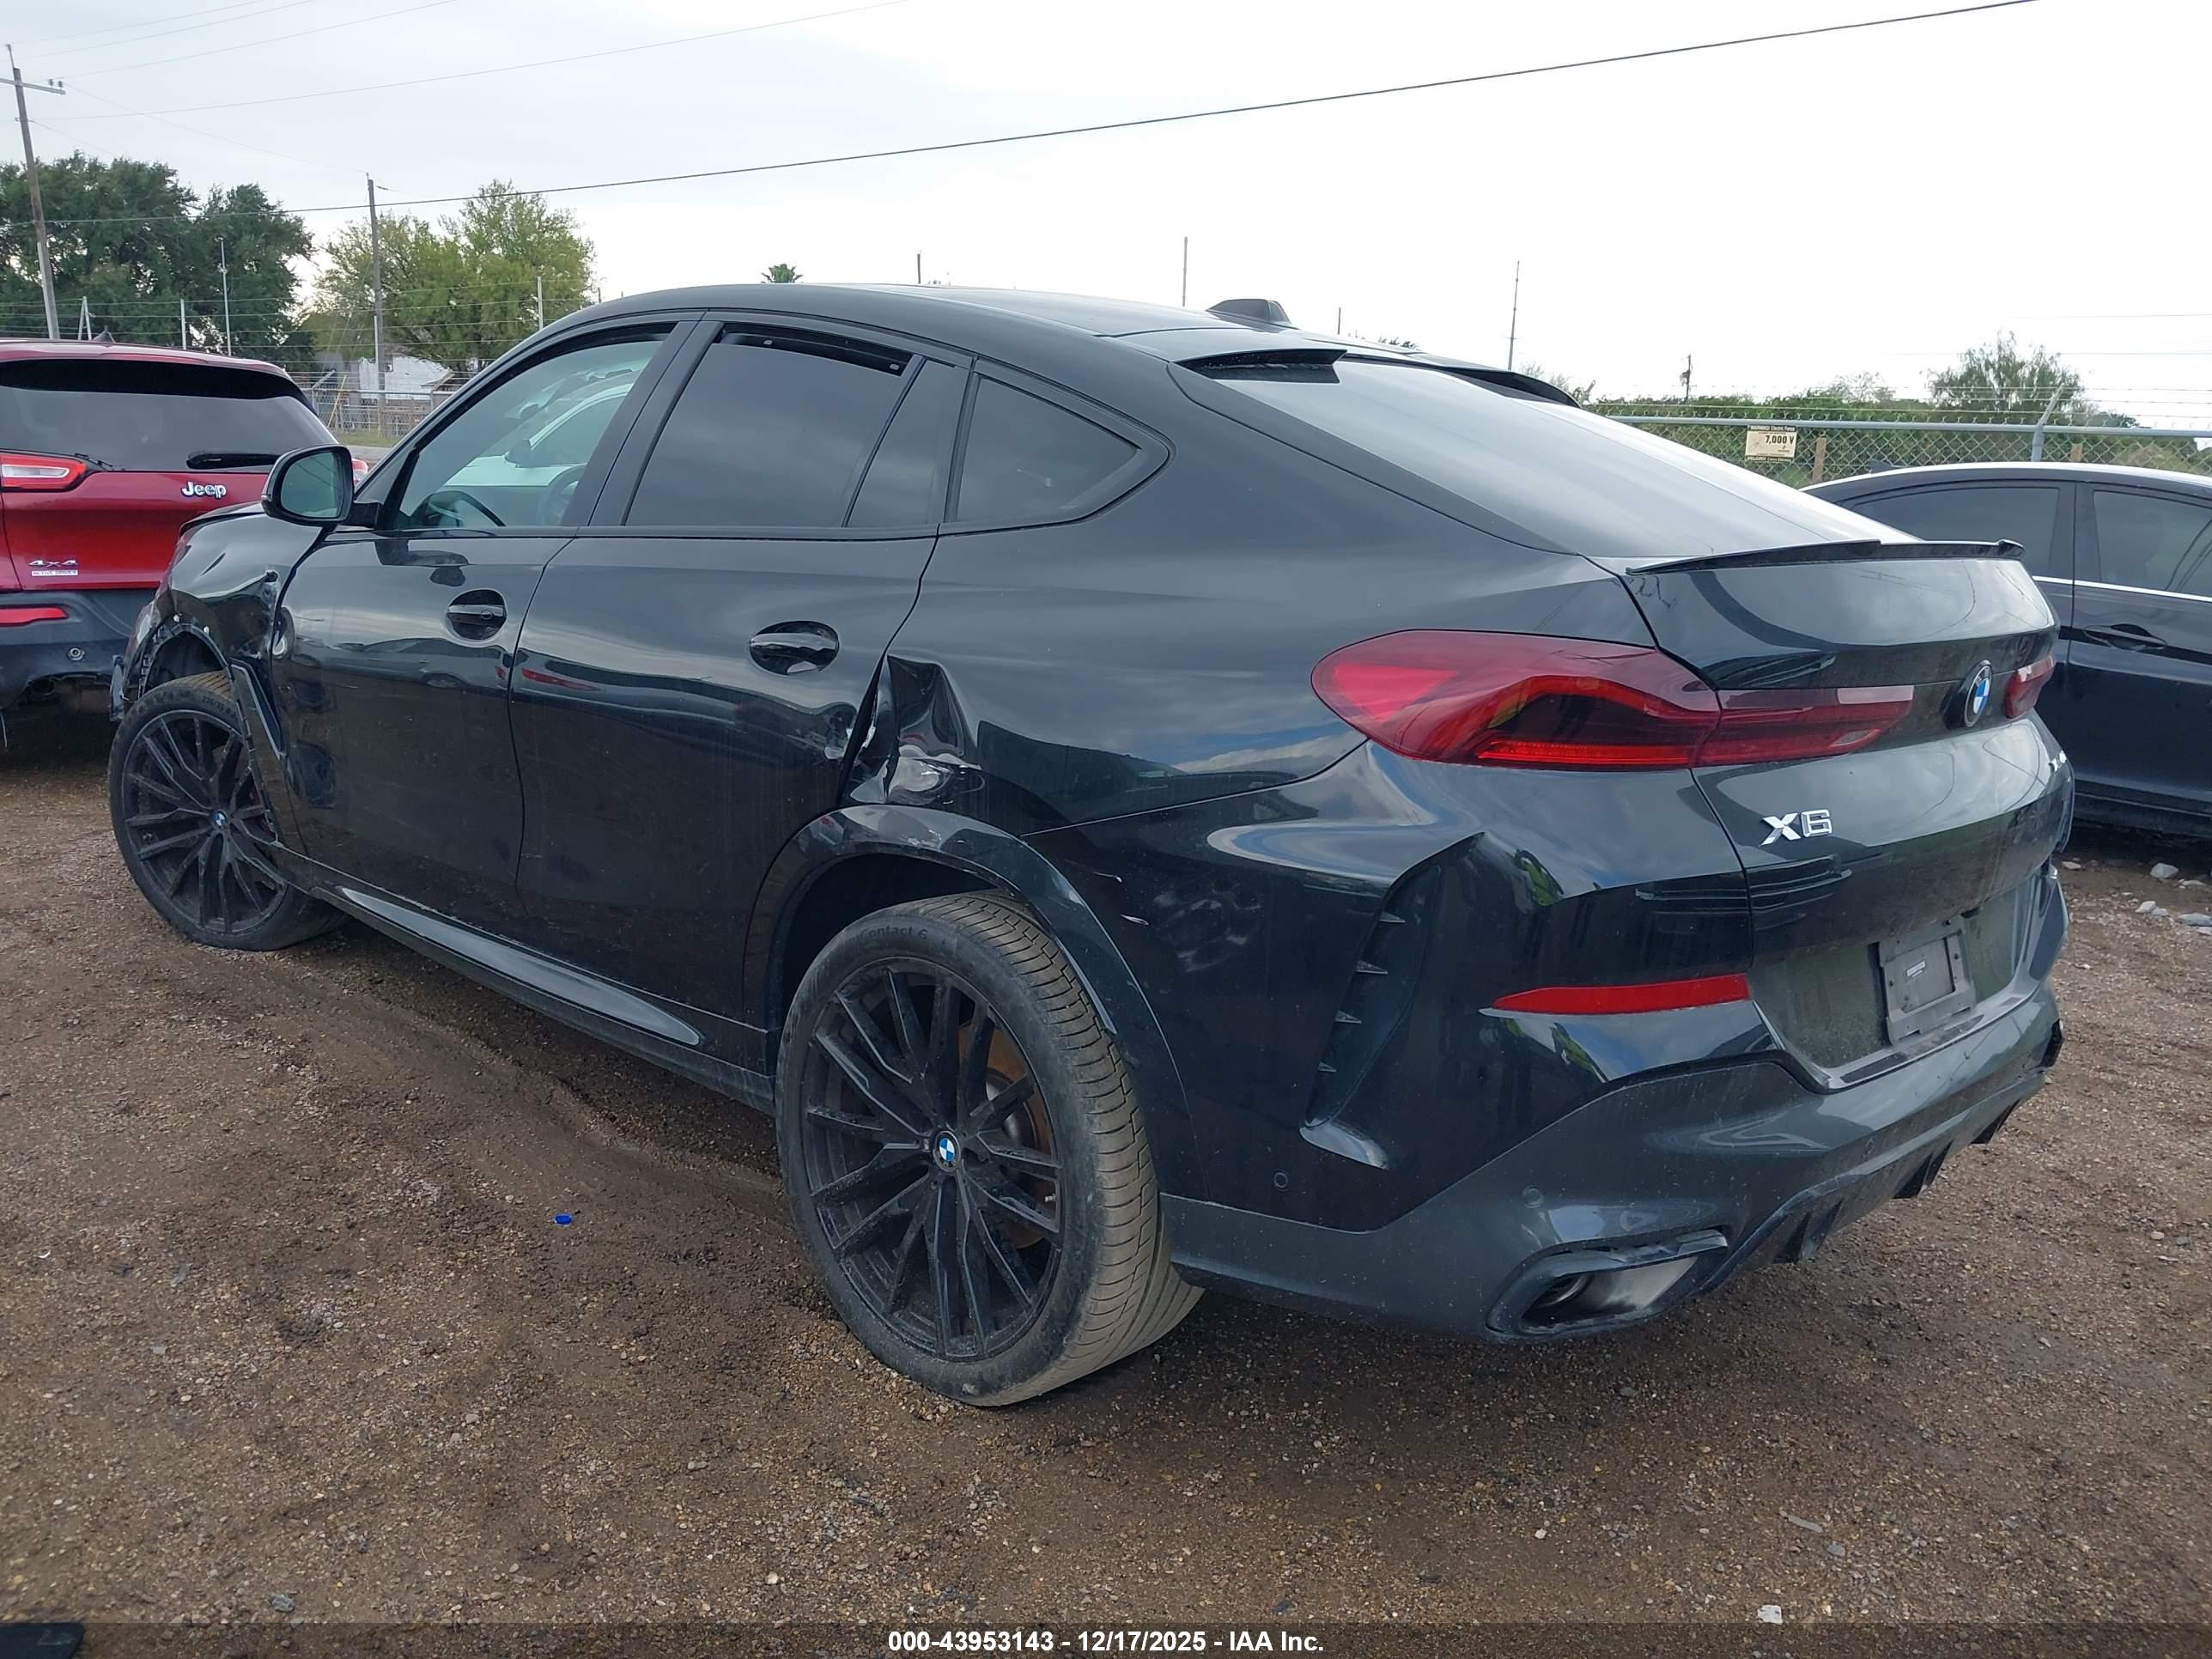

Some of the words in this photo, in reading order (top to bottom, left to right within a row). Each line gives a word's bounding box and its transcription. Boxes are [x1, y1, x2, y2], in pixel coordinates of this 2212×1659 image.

[1765, 434, 1788, 445] 7,000
[1790, 435, 1795, 445] V
[181, 481, 227, 499] Jeep
[1758, 809, 1832, 847] X6
